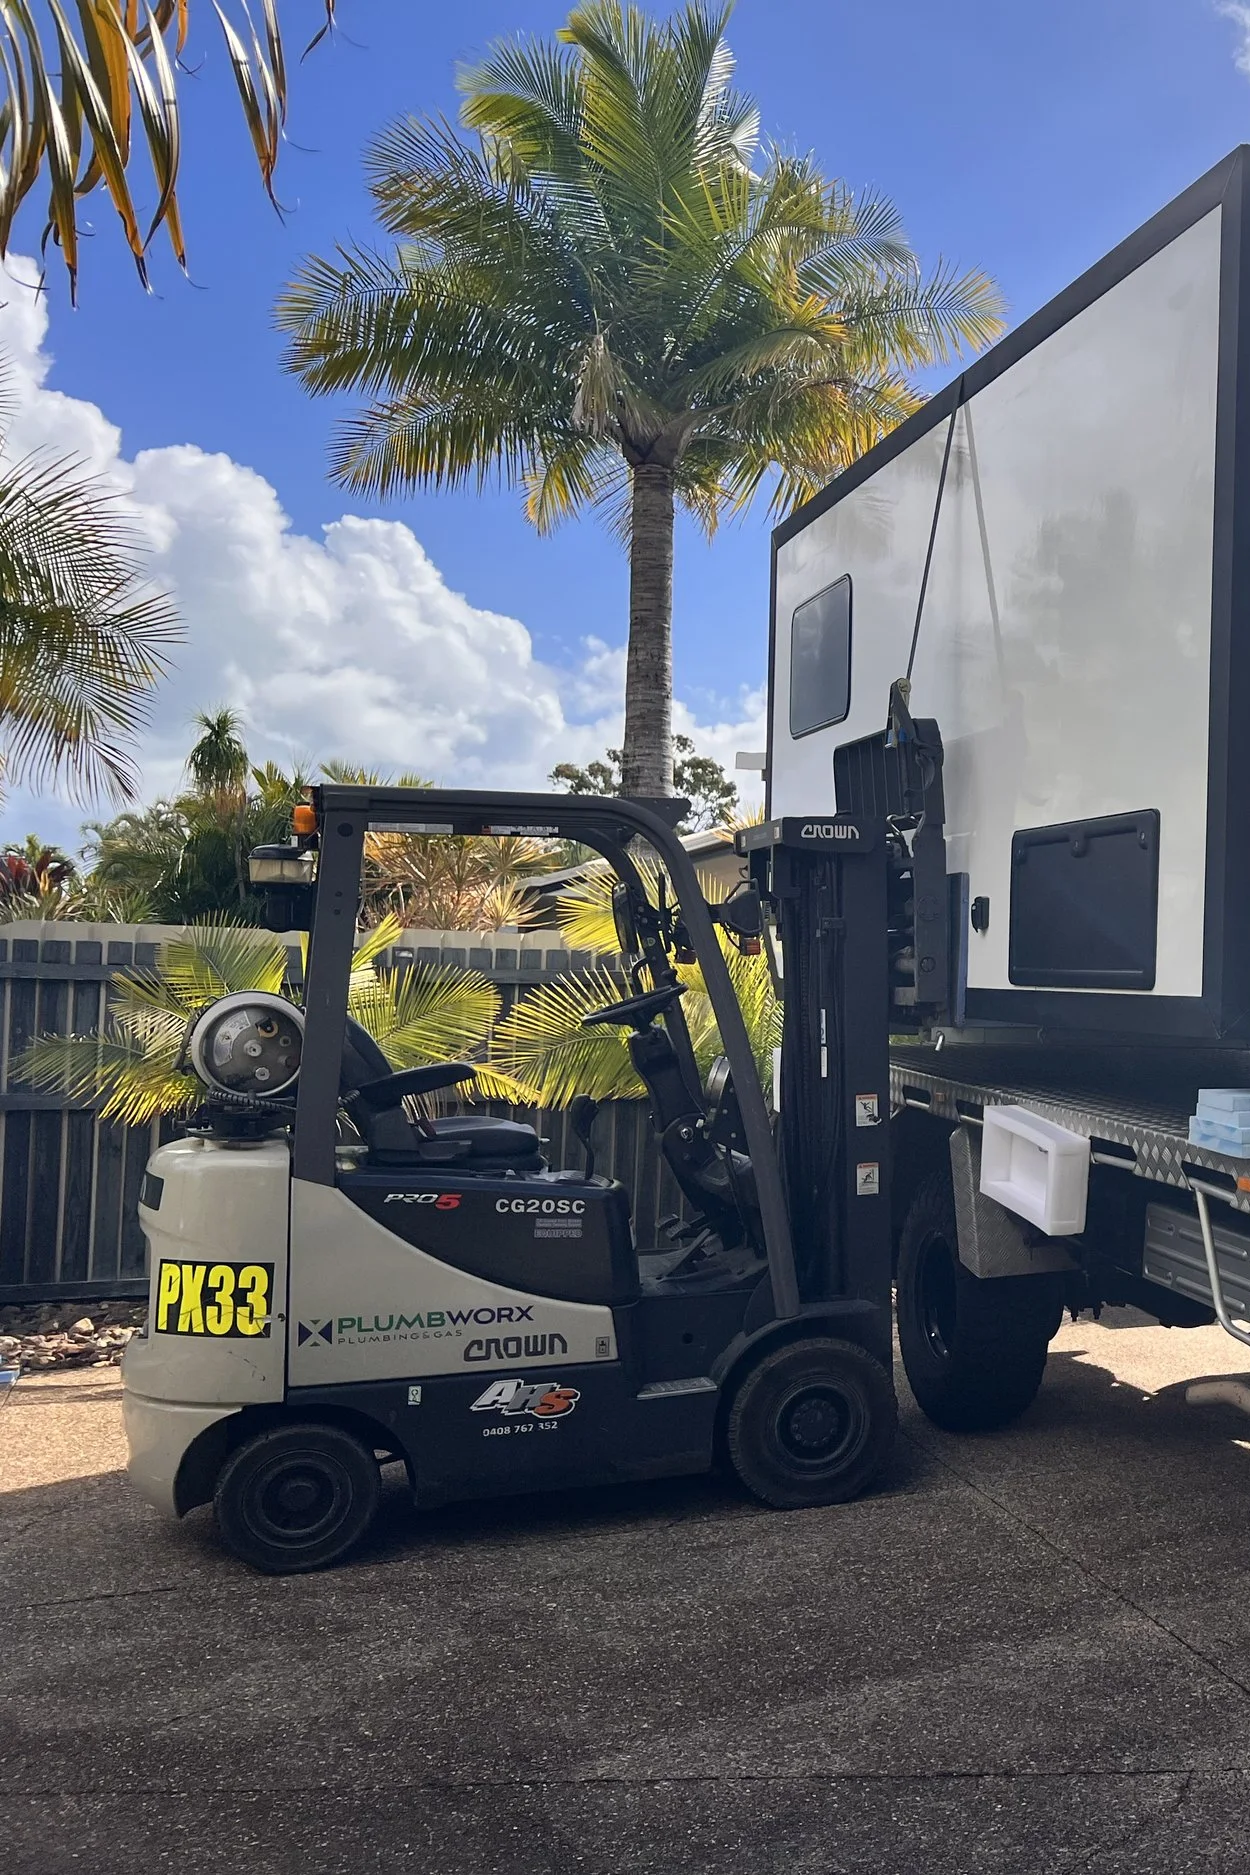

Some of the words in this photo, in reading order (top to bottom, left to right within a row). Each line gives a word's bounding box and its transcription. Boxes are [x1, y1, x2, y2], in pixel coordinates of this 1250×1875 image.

[801, 824, 860, 840] CROWN
[495, 1199, 586, 1214] CG20SC
[157, 1263, 269, 1336] PX33
[337, 1305, 535, 1335] PLUMBWORX
[463, 1333, 568, 1362] CROWN
[470, 1379, 581, 1418] AHS
[482, 1426, 511, 1437] 0408
[514, 1423, 534, 1434] 767
